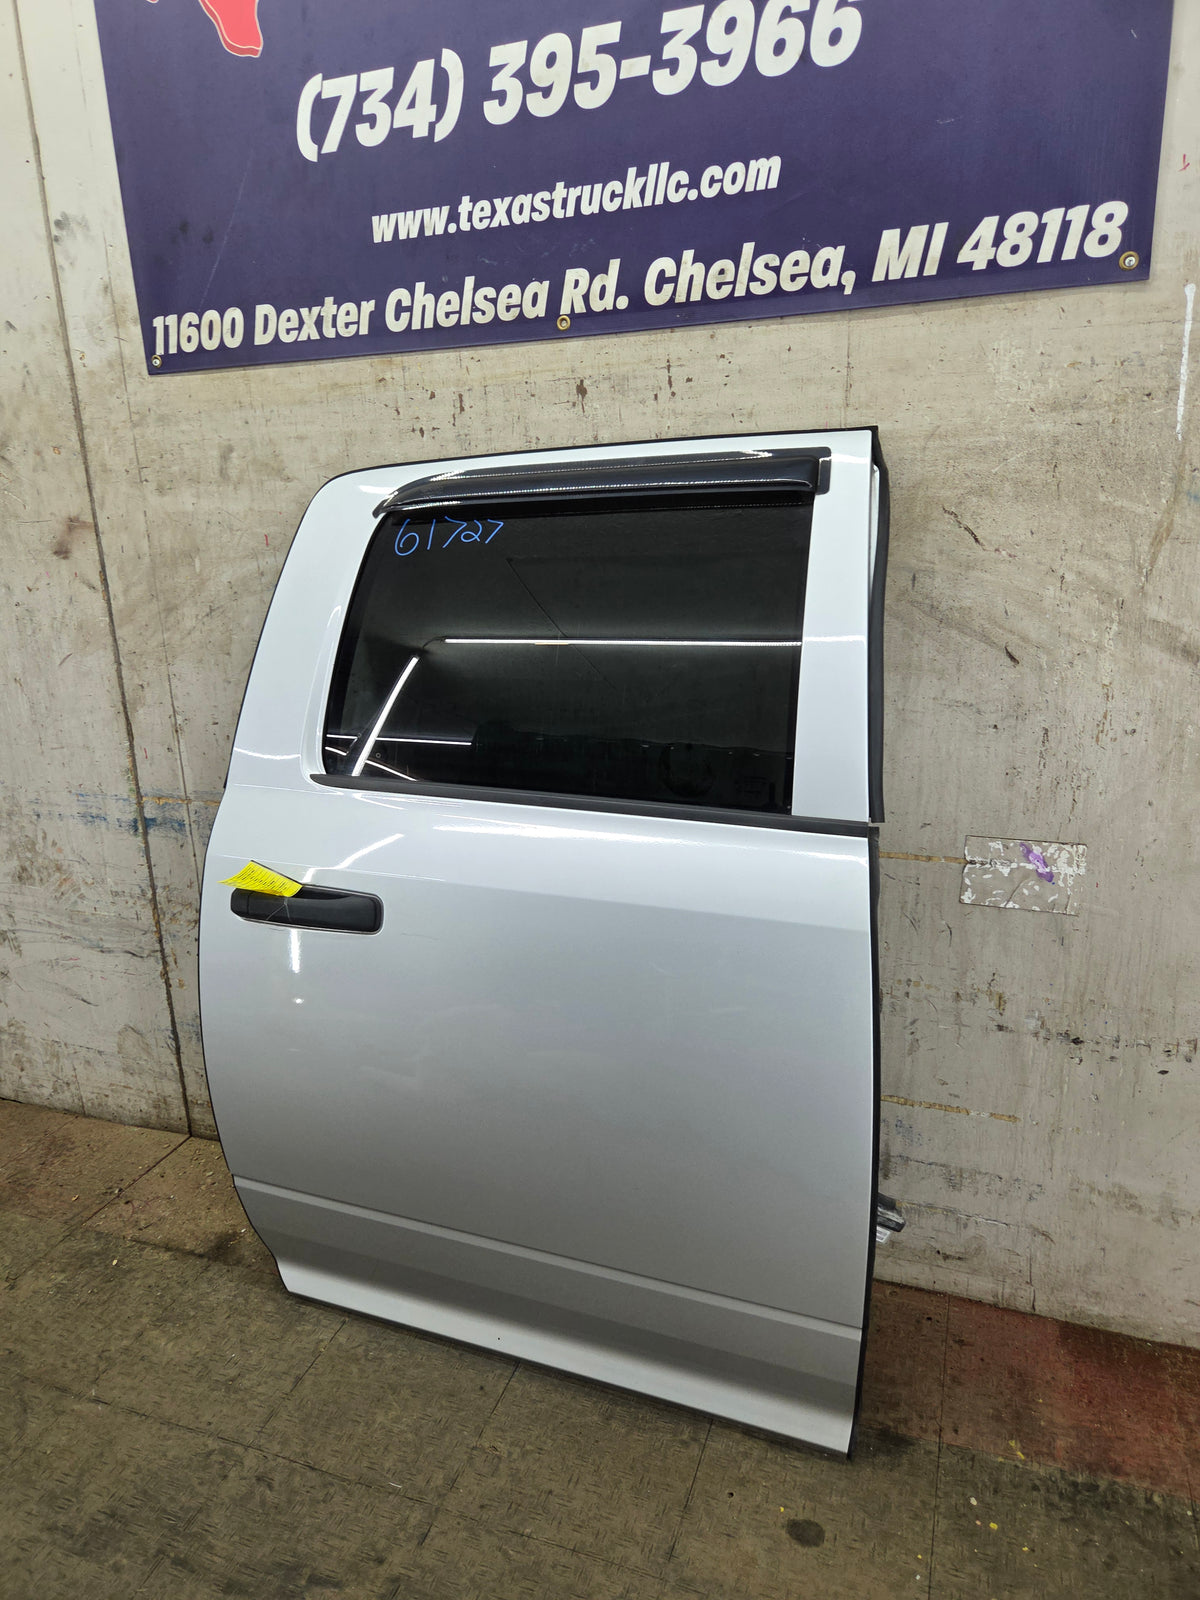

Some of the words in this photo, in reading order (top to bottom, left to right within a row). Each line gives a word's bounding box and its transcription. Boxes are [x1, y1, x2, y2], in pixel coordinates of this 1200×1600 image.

[297, 48, 464, 162] (734)
[483, 0, 863, 125] 395-3966
[372, 156, 782, 243] www.texastruckllc.com
[153, 307, 245, 356] 11600
[254, 297, 376, 345] Dexter
[385, 276, 550, 332] Chelsea
[560, 259, 629, 315] Rd.
[645, 242, 856, 306] Chelsea,
[872, 222, 949, 282] MI
[957, 201, 1129, 270] 48118
[394, 516, 504, 556] 61727
